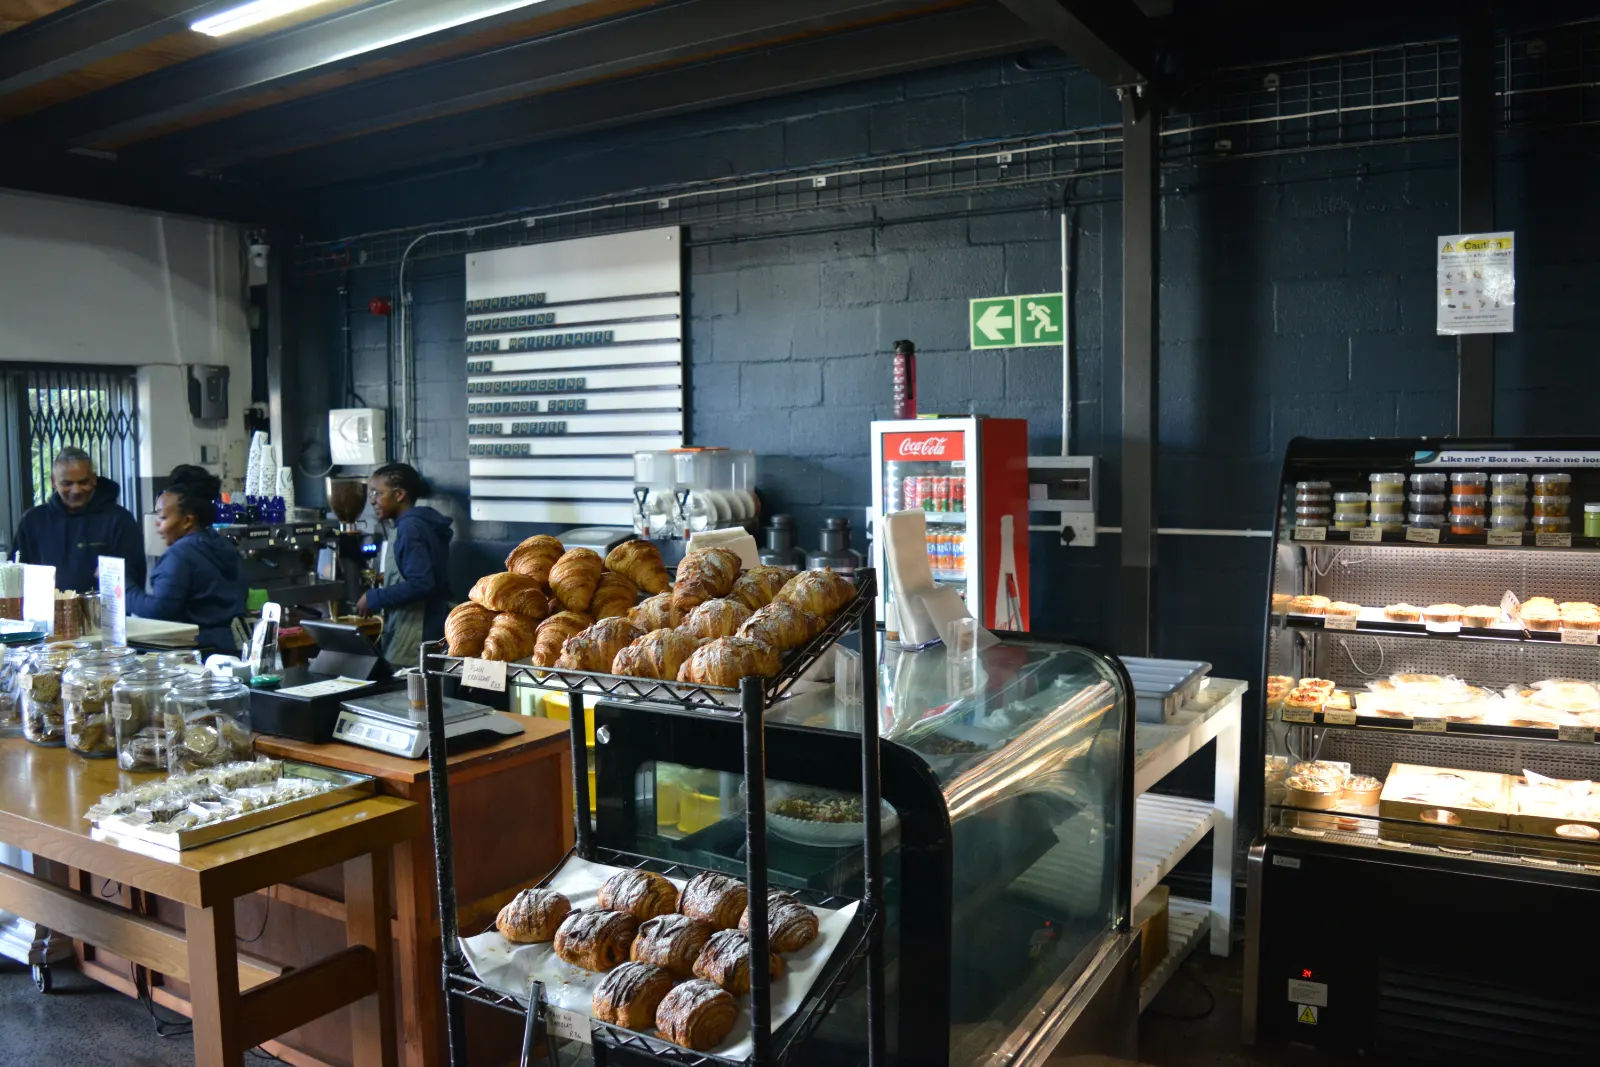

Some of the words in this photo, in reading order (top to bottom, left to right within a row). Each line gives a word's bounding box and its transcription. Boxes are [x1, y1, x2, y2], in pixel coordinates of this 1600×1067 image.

[466, 294, 544, 309] AMERICANO
[466, 313, 554, 329] CAPPUCCINO
[466, 340, 499, 349] FLAT
[509, 331, 611, 346] WHITE/LATTE
[467, 362, 491, 370] TEA
[469, 401, 538, 411] CHAI/HOT
[549, 399, 585, 409] CHOC
[469, 423, 501, 432] ICED
[512, 422, 565, 432] COFFEE
[899, 437, 948, 456] Coca-Cola
